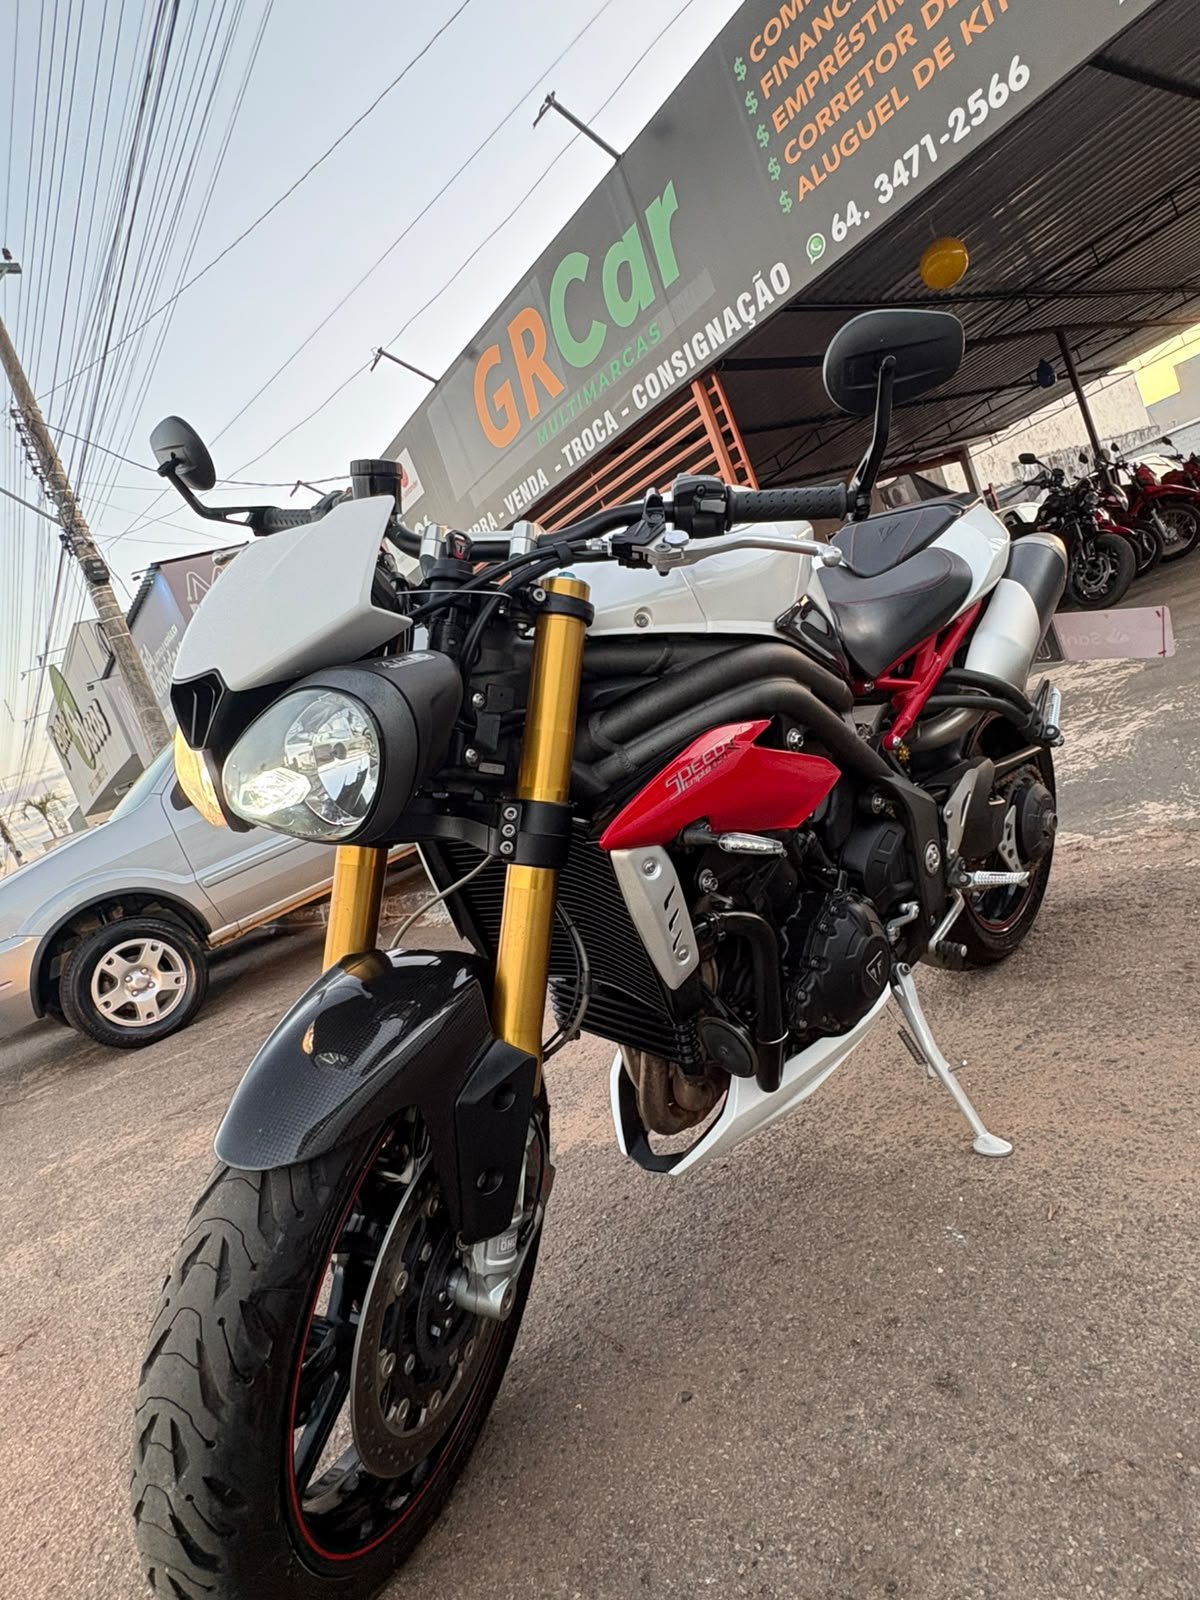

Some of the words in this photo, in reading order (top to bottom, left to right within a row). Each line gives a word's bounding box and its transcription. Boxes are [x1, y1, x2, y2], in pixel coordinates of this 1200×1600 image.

[760, 0, 856, 100] FINANC
[784, 23, 918, 165] CORRETOR
[920, 0, 960, 31] D
[797, 86, 910, 202] ALUGUEL
[911, 36, 956, 91] DE
[874, 54, 1031, 204] 3471-2566
[503, 467, 550, 515] VENDA
[561, 409, 619, 467] TROCA
[631, 261, 791, 410] CONSIGNAÇÃO
[535, 321, 662, 447] MULTIMARCAS
